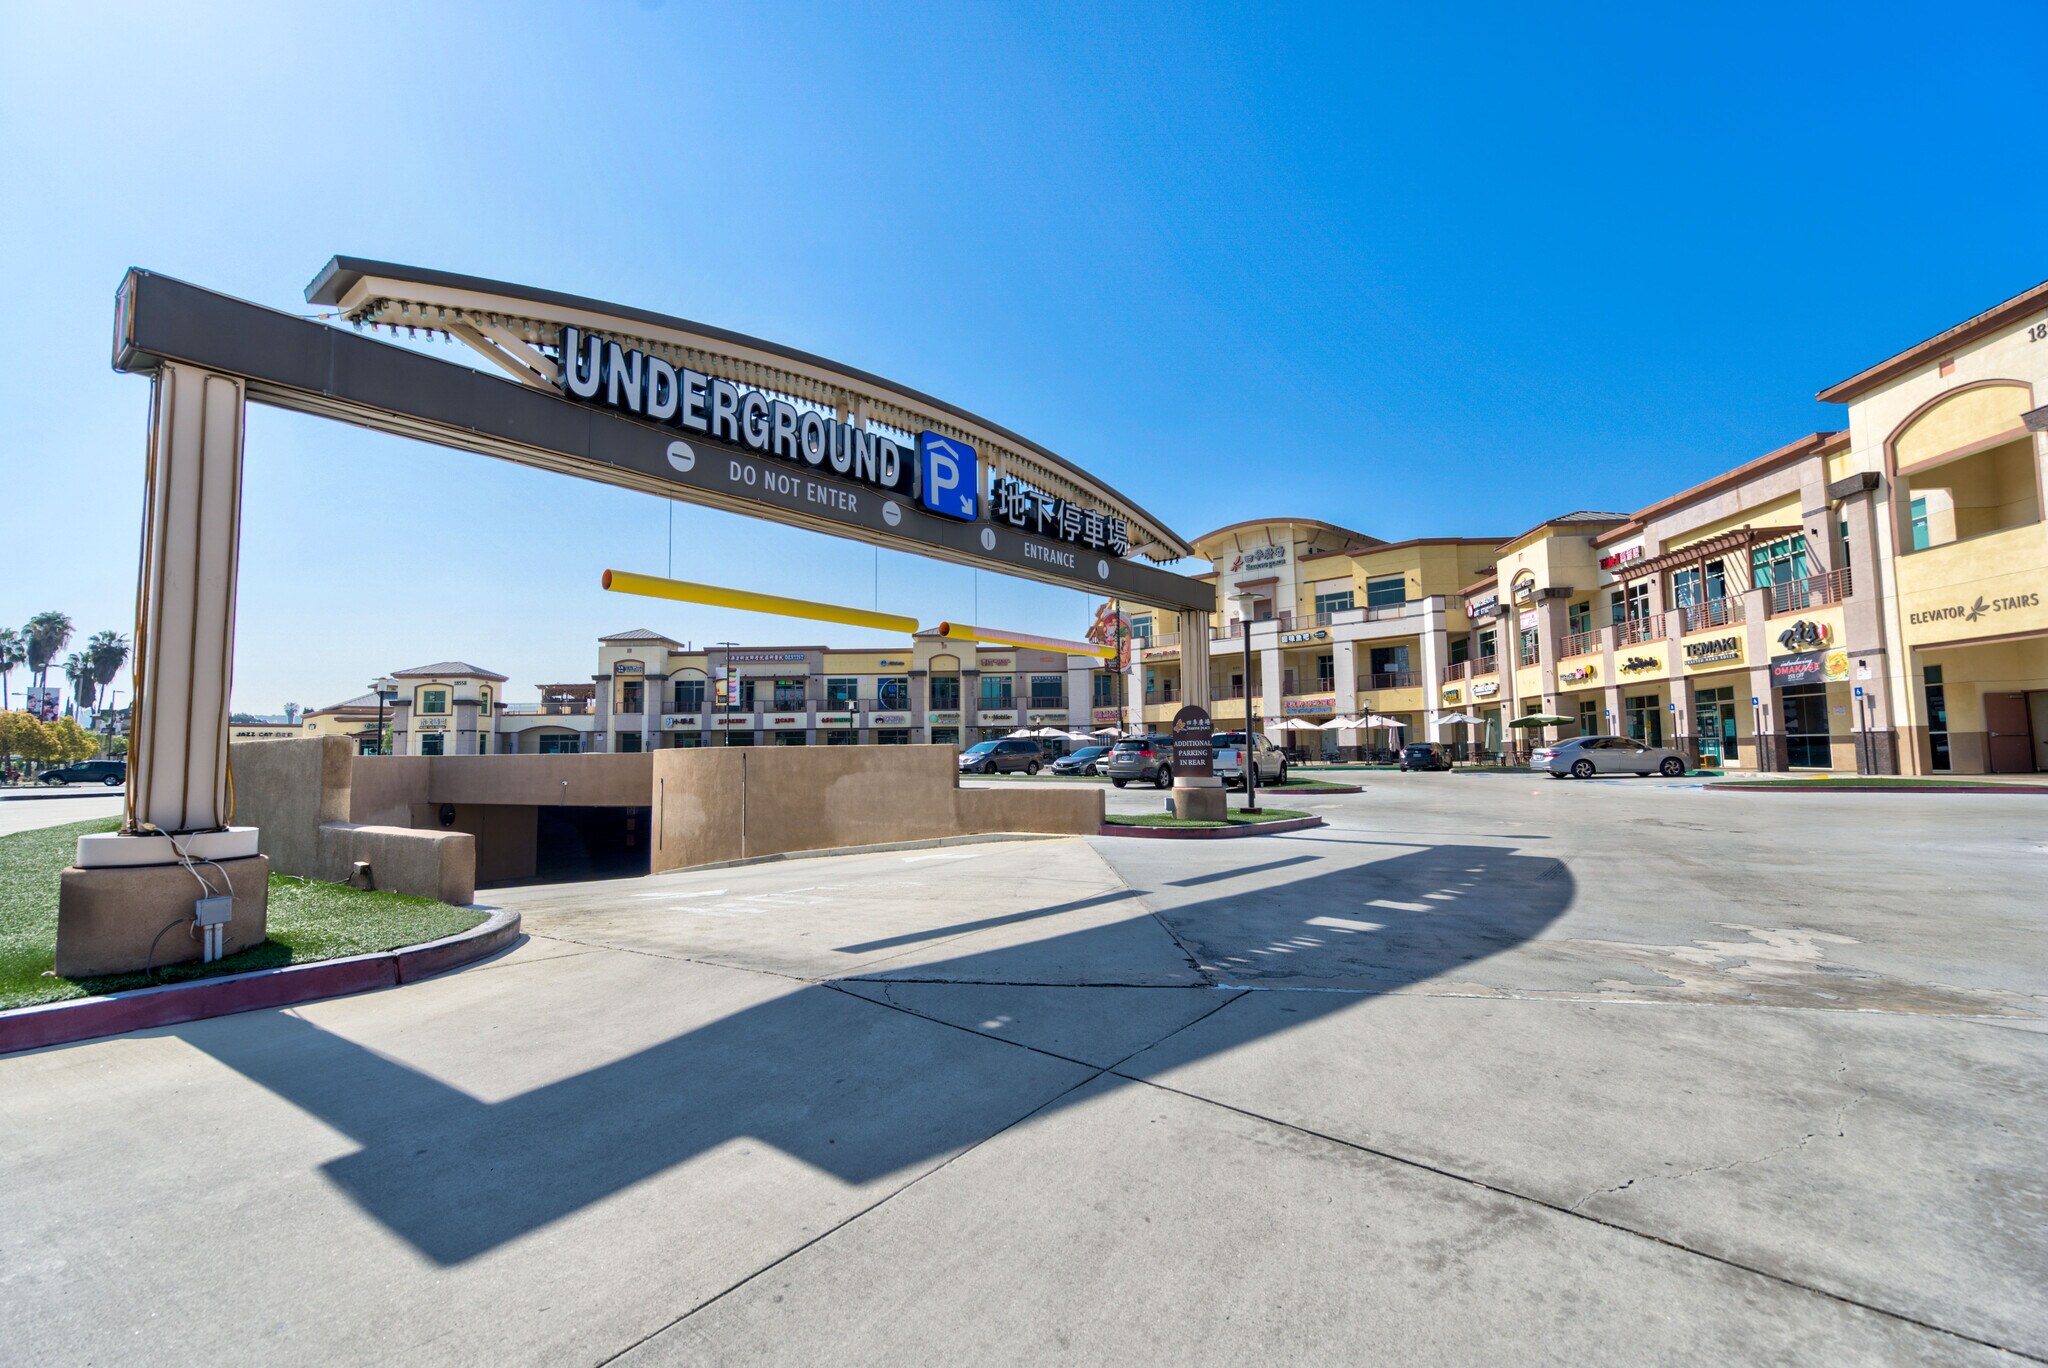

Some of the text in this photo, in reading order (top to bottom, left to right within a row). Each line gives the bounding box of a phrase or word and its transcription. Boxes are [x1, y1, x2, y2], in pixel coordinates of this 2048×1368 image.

[2028, 323, 2048, 343] 18
[560, 326, 901, 488] UNDERGROUND
[729, 461, 857, 513] DO NOT ENTER
[930, 452, 959, 505] P
[996, 479, 1129, 556] 地下停車場
[1024, 542, 1075, 569] ENTRANCE
[1910, 593, 2040, 625] ELEVATOR STAIRS
[1683, 637, 1737, 657] TEMAKI
[1774, 662, 1820, 675] OMAKASE
[1781, 656, 1813, 668] introducing
